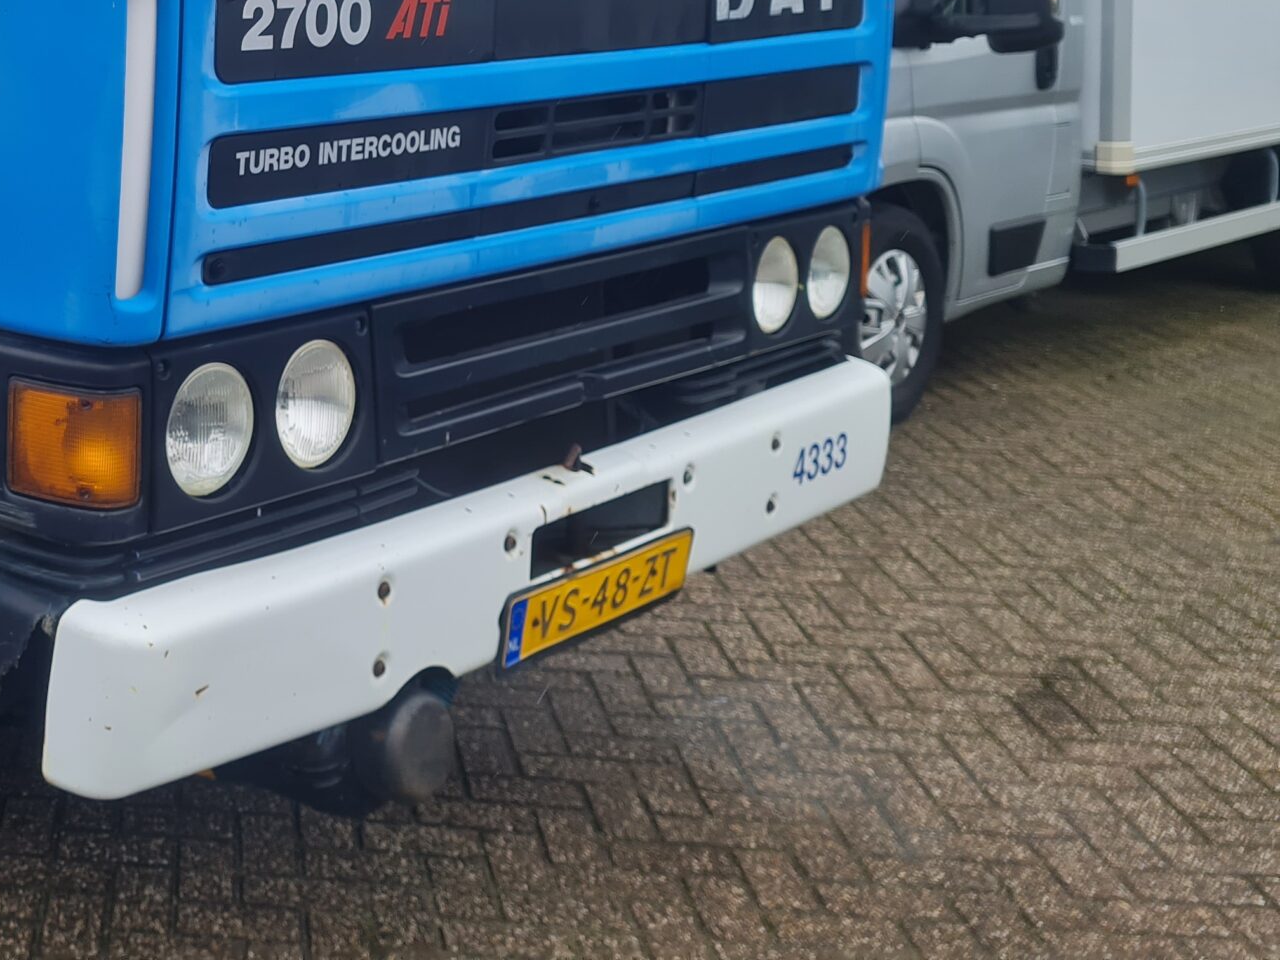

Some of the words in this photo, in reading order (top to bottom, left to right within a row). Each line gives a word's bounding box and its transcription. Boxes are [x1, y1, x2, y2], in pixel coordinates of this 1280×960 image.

[236, 143, 310, 176] TURBO
[318, 125, 461, 166] INTERCOOLING
[792, 432, 848, 485] 4333
[540, 547, 677, 639] VS-48-ZT
